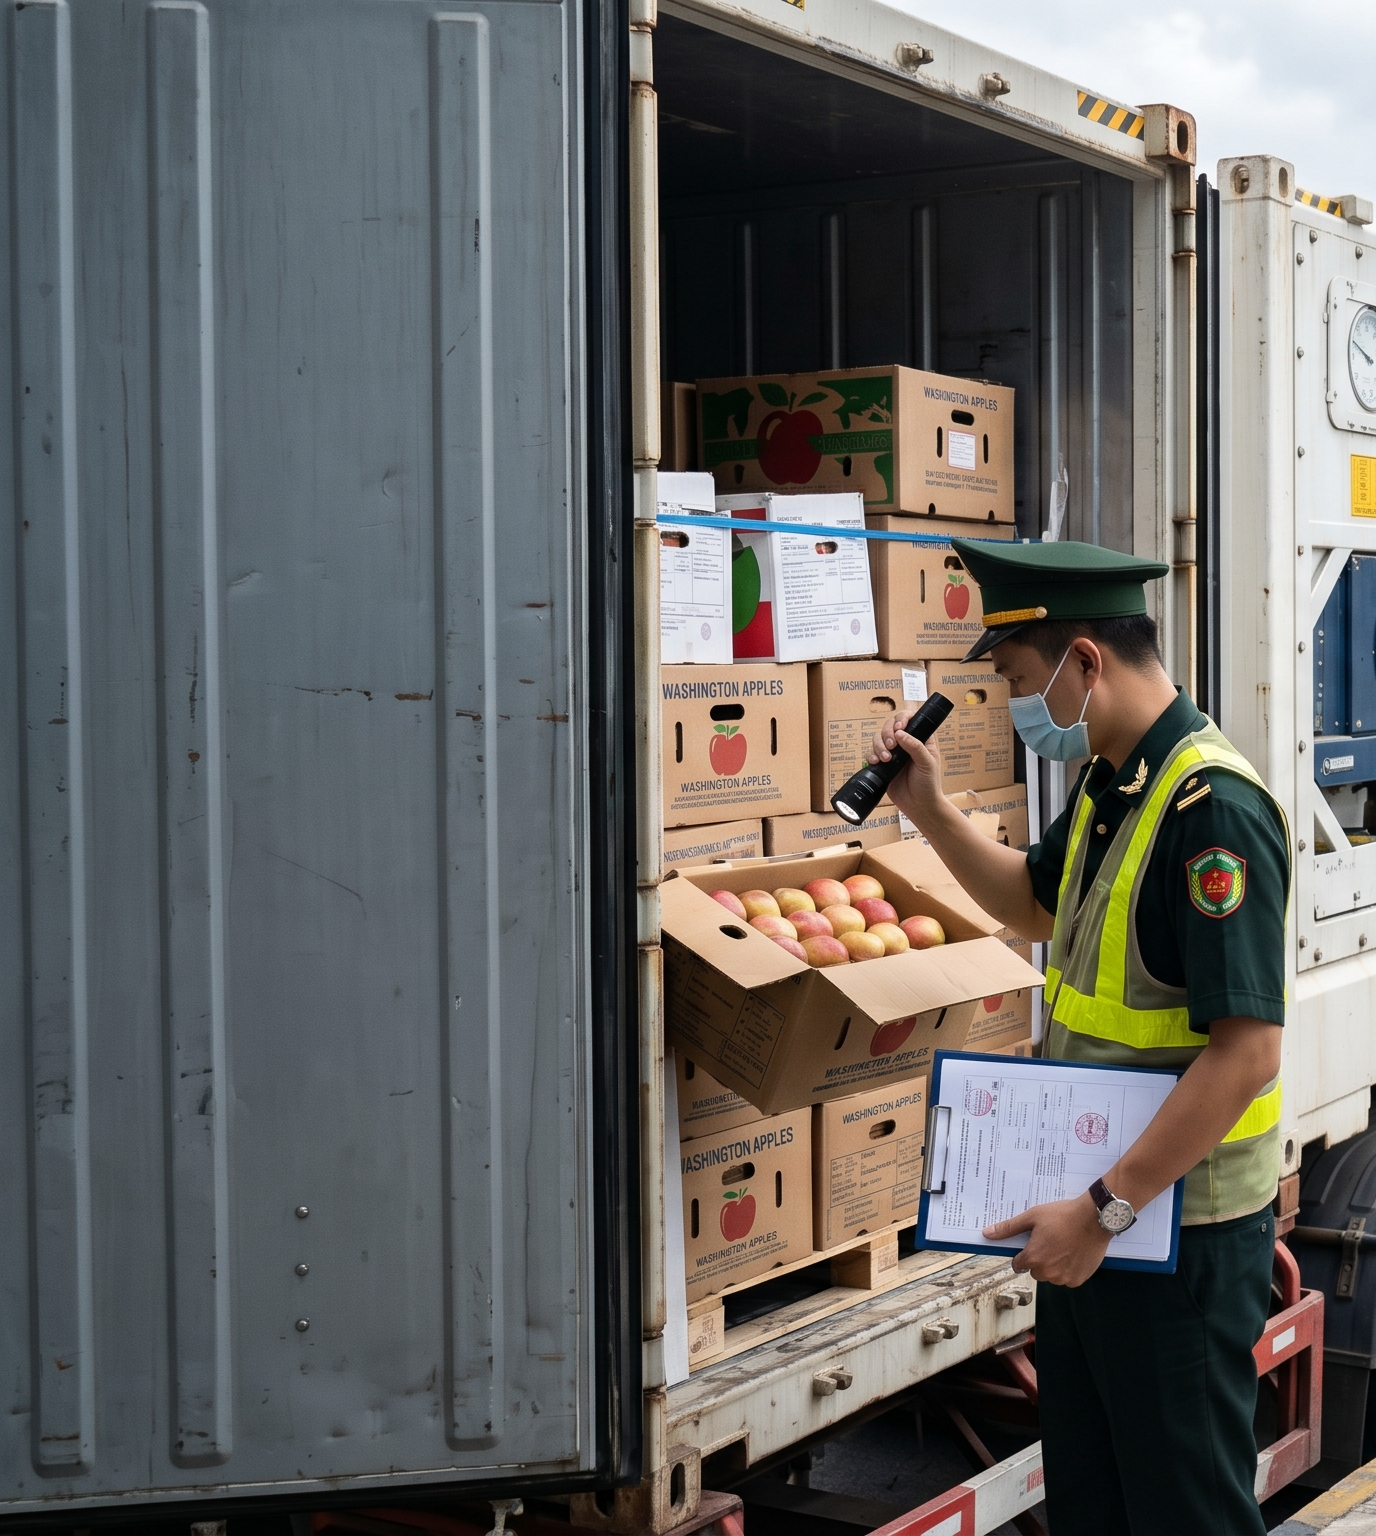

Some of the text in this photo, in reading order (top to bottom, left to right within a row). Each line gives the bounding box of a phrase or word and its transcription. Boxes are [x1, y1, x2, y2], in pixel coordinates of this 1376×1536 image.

[924, 386, 998, 412] WASHINGTON APPLES
[662, 680, 783, 700] WASHINGTON APPLES
[681, 775, 771, 793] WASHINGTON APPLES
[842, 1092, 922, 1125] WASHINGTON APPLES
[753, 1126, 793, 1154] APPLES
[748, 1230, 777, 1249] APPLES
